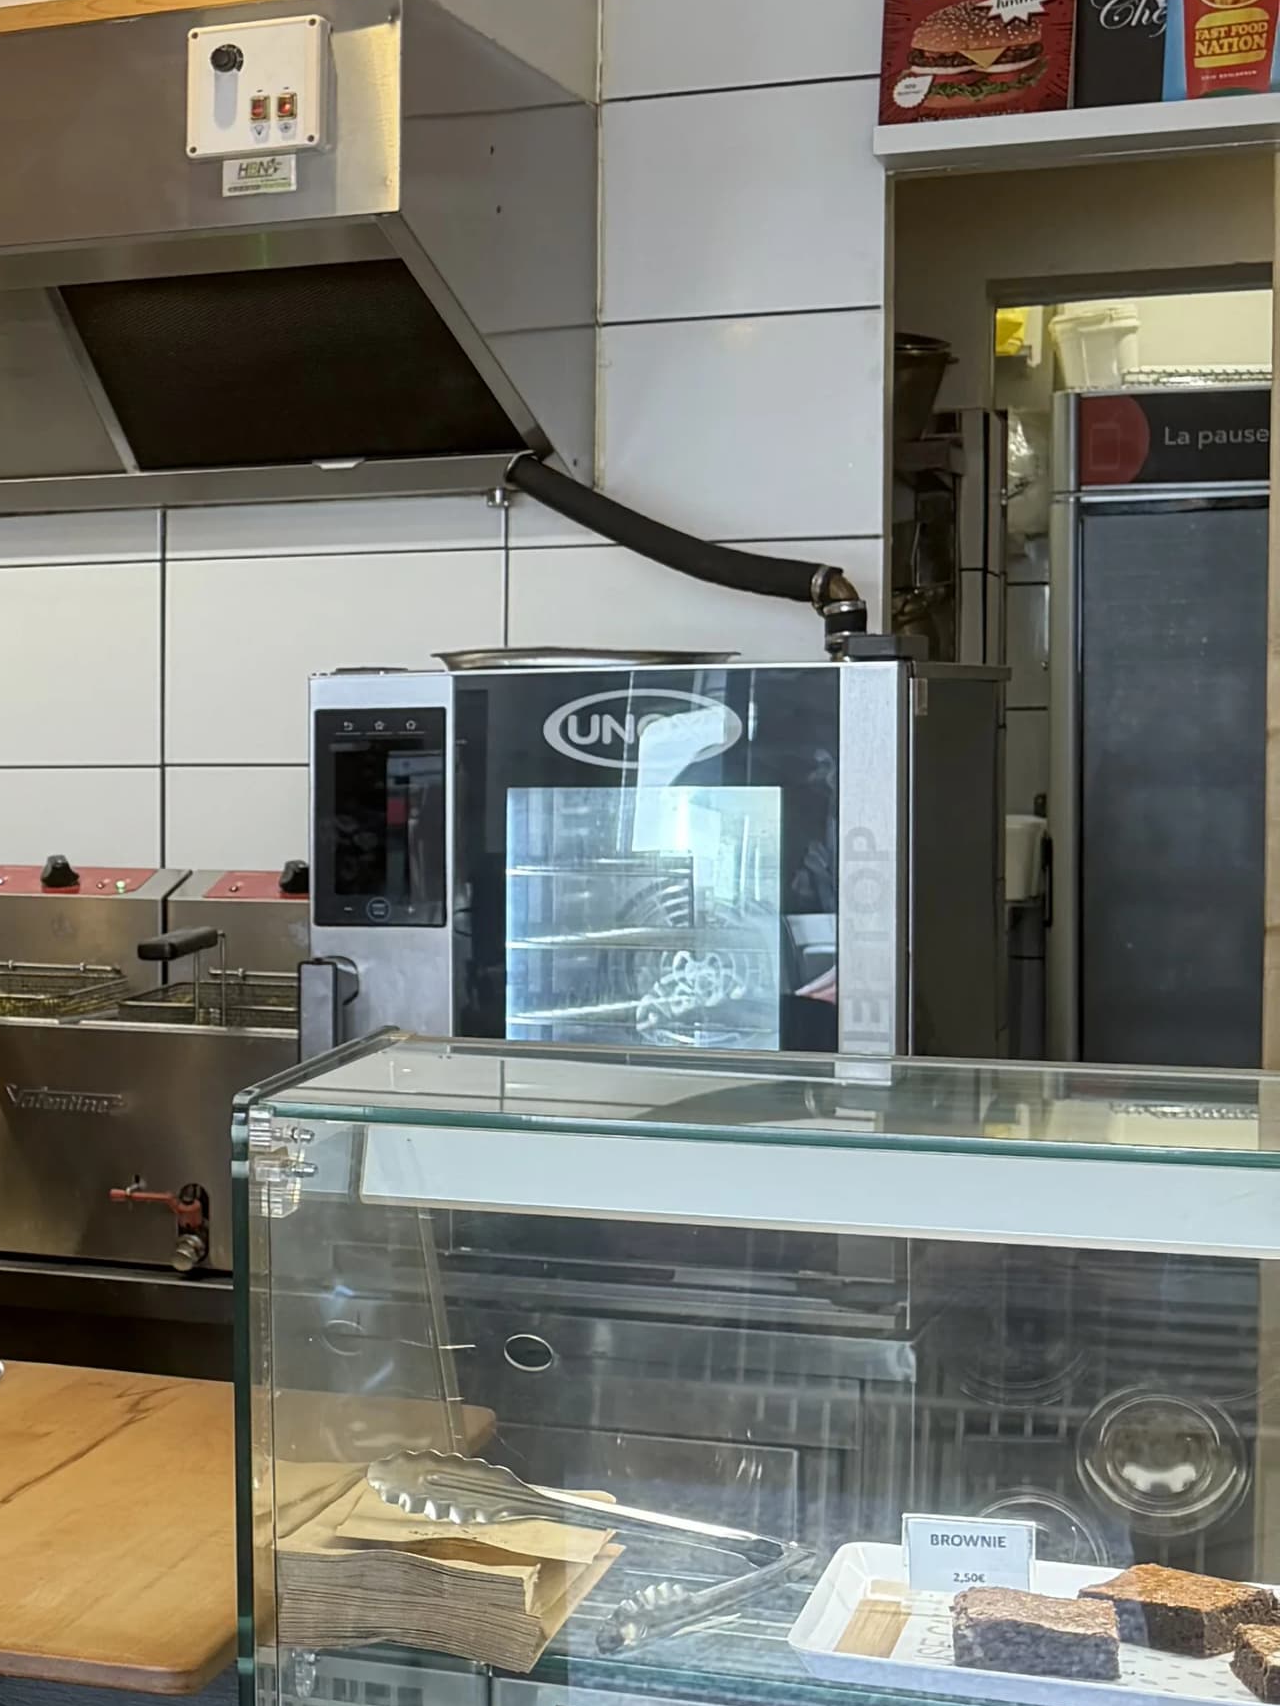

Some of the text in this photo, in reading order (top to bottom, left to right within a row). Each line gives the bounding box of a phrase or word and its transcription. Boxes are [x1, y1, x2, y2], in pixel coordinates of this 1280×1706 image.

[1195, 21, 1268, 41] FAST FOOD
[1195, 33, 1268, 57] NATION
[1164, 426, 1269, 451] La pause
[930, 1533, 1007, 1549] BROWNIE
[953, 1572, 987, 1584] 2,50€
